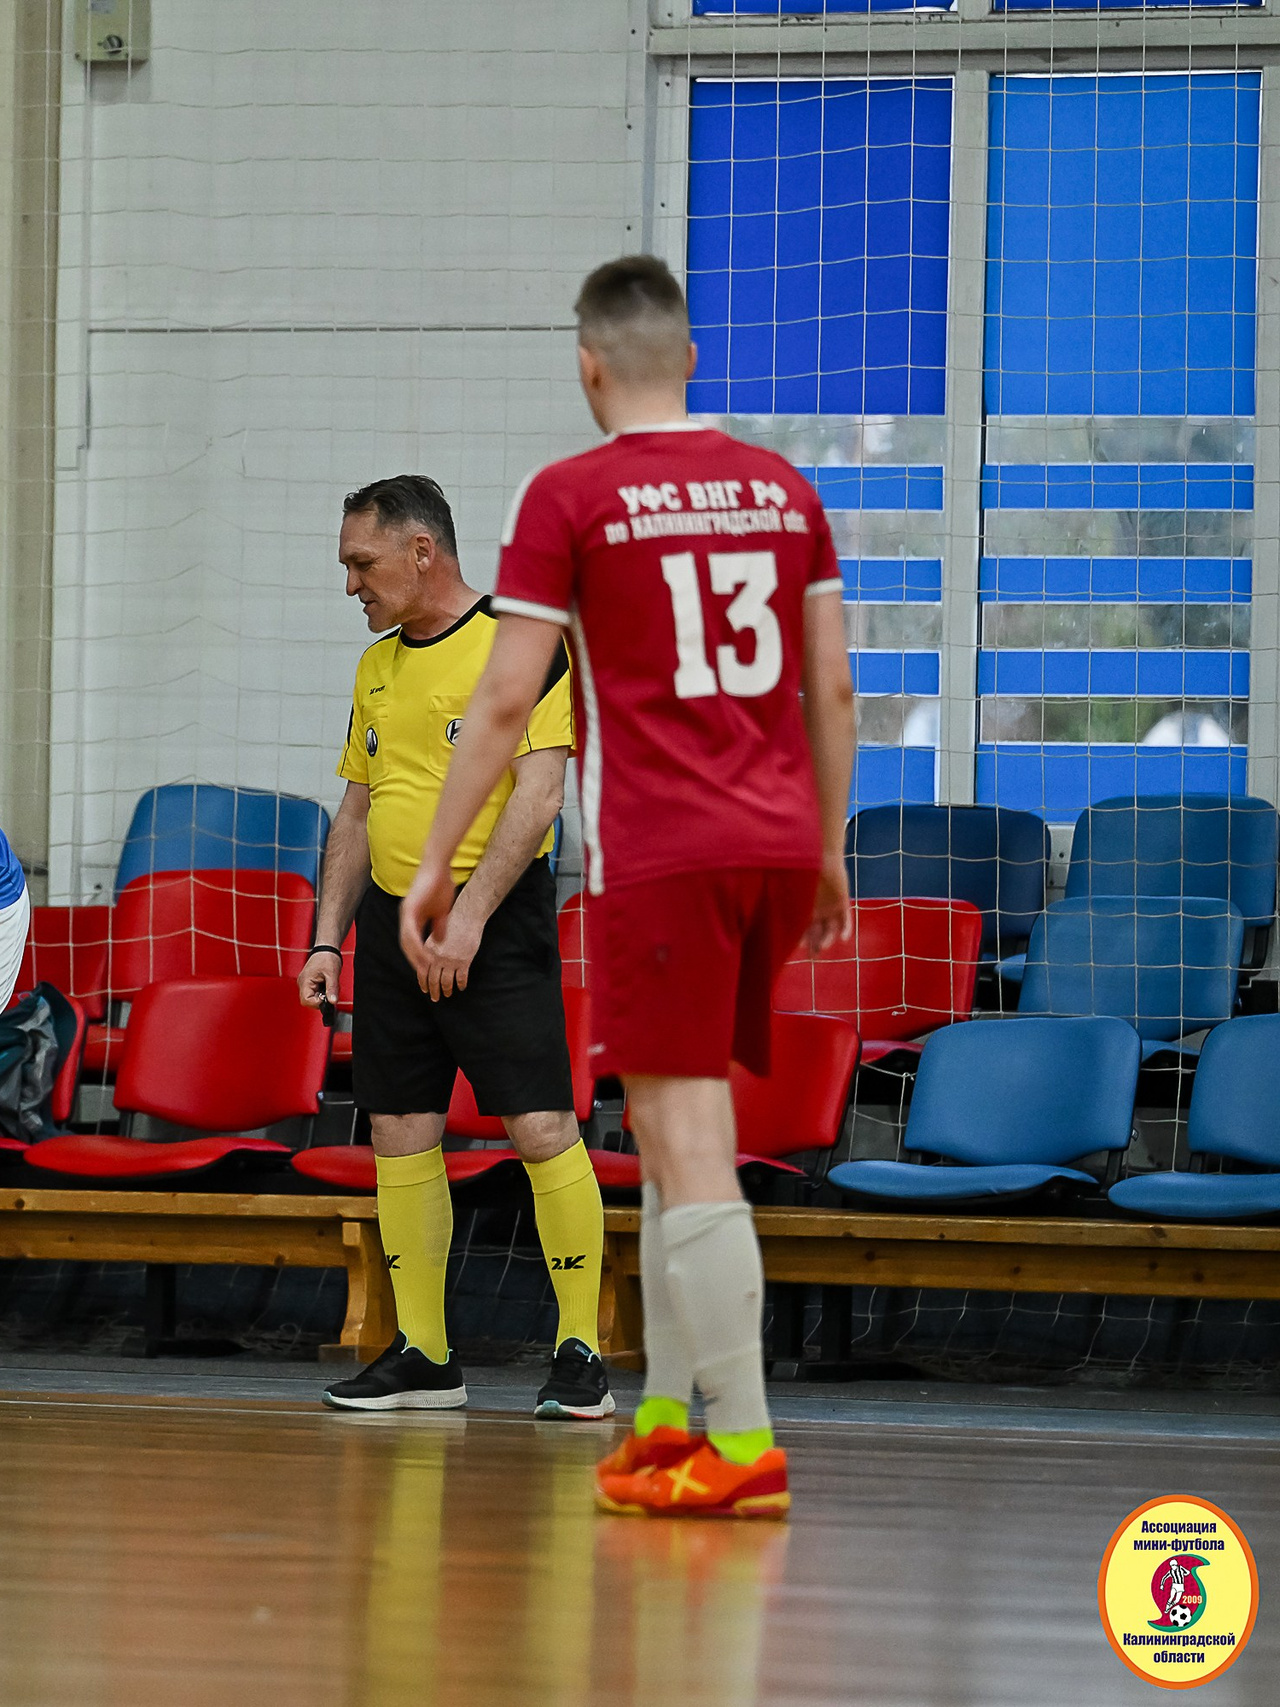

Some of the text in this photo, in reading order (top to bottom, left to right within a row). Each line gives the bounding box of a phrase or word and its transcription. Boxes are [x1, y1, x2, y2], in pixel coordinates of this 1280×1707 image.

[618, 479, 788, 515] УФС ВНГ РФ
[661, 552, 783, 698] 13
[551, 1254, 586, 1270] 2K
